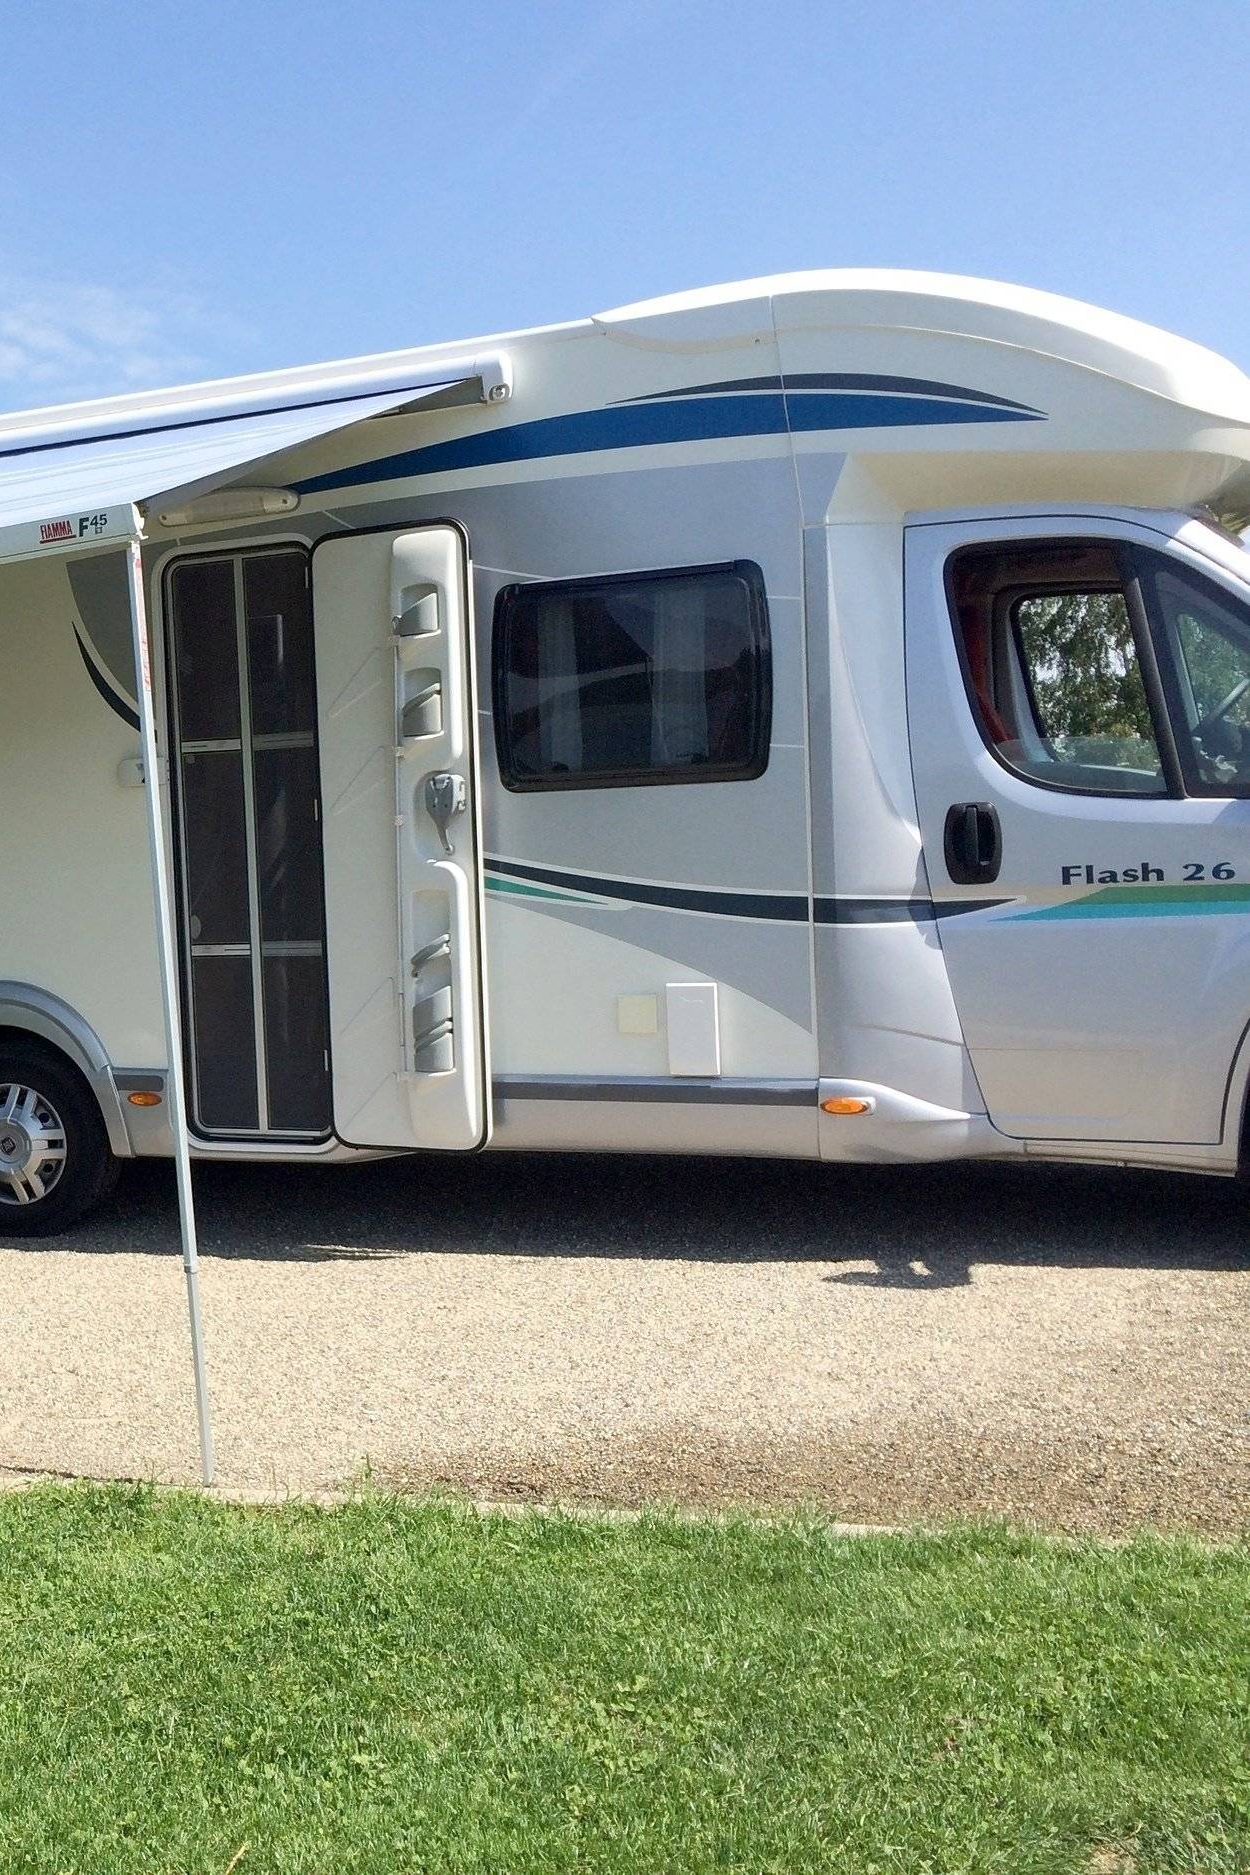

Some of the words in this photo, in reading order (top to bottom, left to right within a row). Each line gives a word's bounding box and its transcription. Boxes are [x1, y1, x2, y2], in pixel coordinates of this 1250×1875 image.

[39, 520, 73, 540] FIAMMA
[78, 513, 108, 538] F45
[1061, 862, 1165, 886] Flash
[1182, 861, 1236, 882] 26
